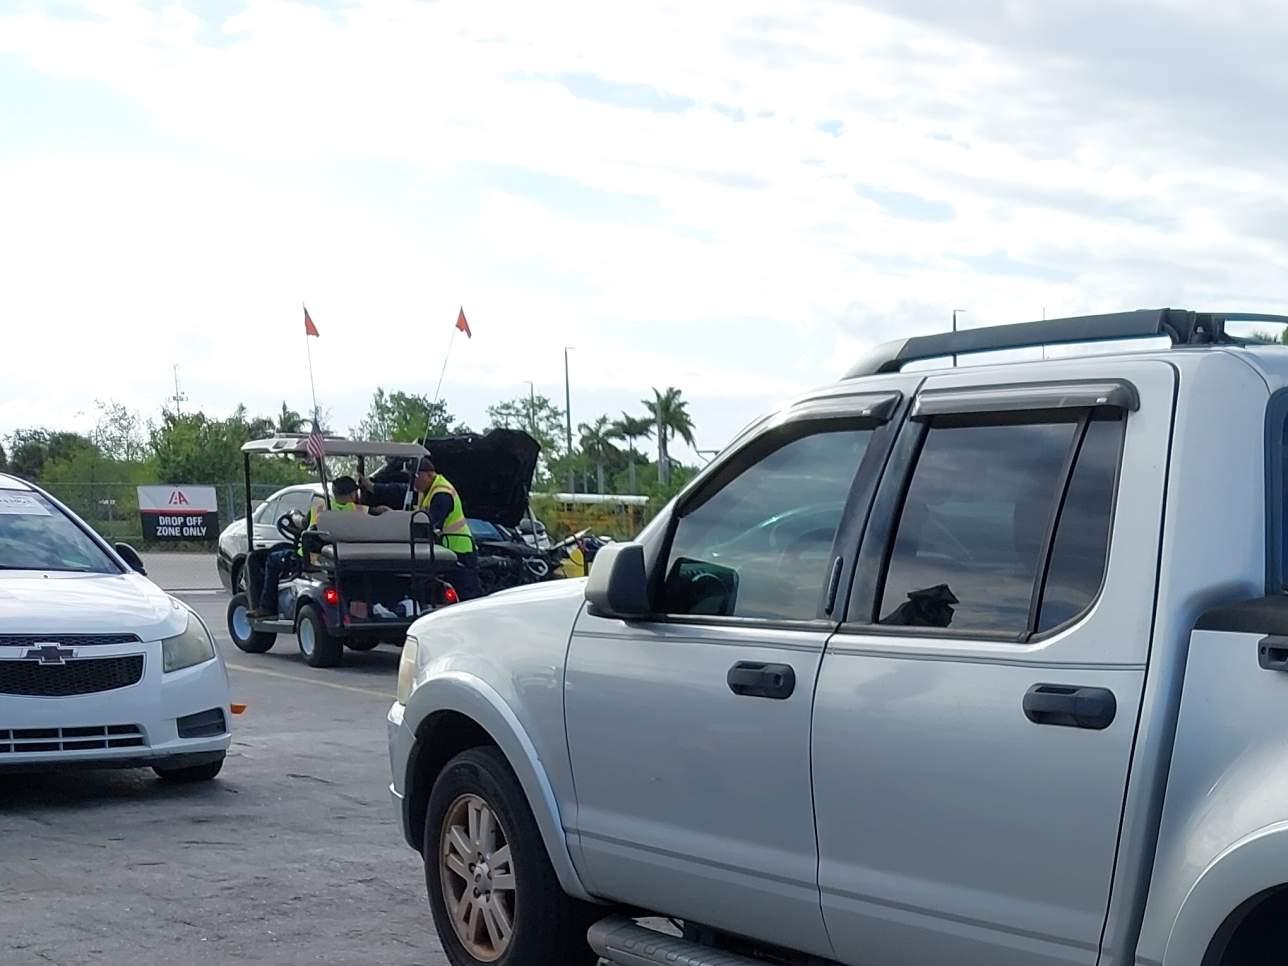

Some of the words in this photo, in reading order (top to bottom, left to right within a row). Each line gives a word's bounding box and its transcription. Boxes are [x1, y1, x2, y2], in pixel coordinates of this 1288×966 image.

[158, 516, 184, 526] DROP
[186, 516, 203, 526] OFF
[156, 526, 181, 537] ZONE
[183, 526, 207, 537] ONLY
